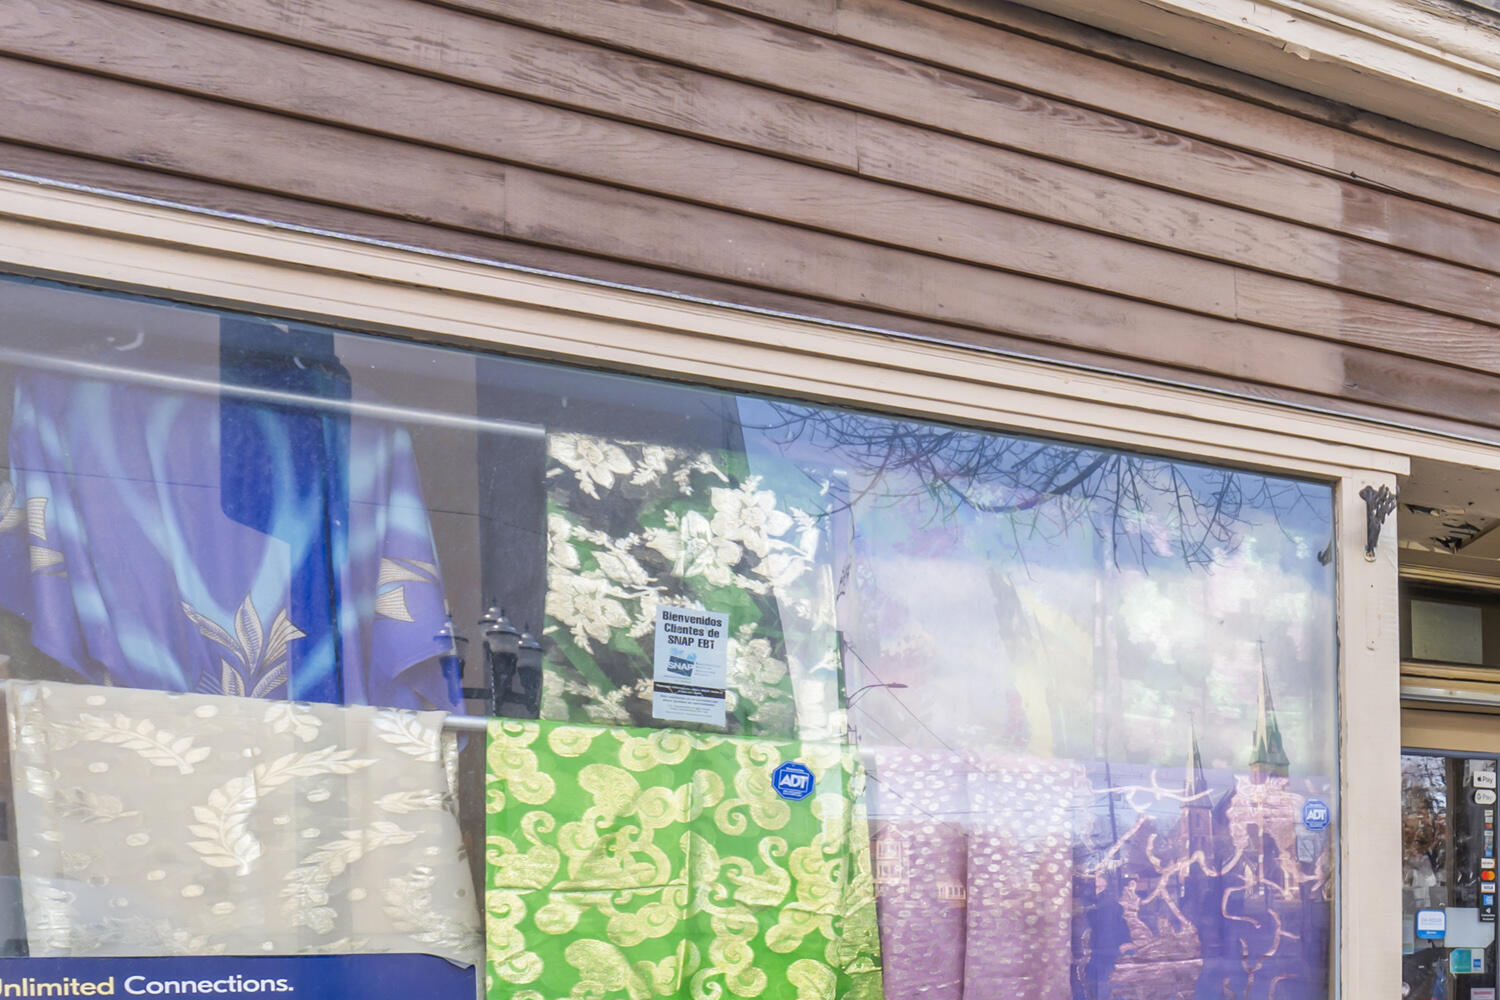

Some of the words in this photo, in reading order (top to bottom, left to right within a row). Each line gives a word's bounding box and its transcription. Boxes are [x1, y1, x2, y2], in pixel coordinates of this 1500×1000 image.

[662, 610, 723, 627] Bienvenidos
[664, 622, 705, 637] Clientes
[707, 629, 720, 638] de
[668, 635, 694, 646] SNAP
[698, 639, 715, 649] EBT
[780, 774, 808, 789] ADT
[1306, 809, 1326, 820] ADT
[0, 976, 115, 997] nlimited
[124, 974, 294, 996] Connections.
